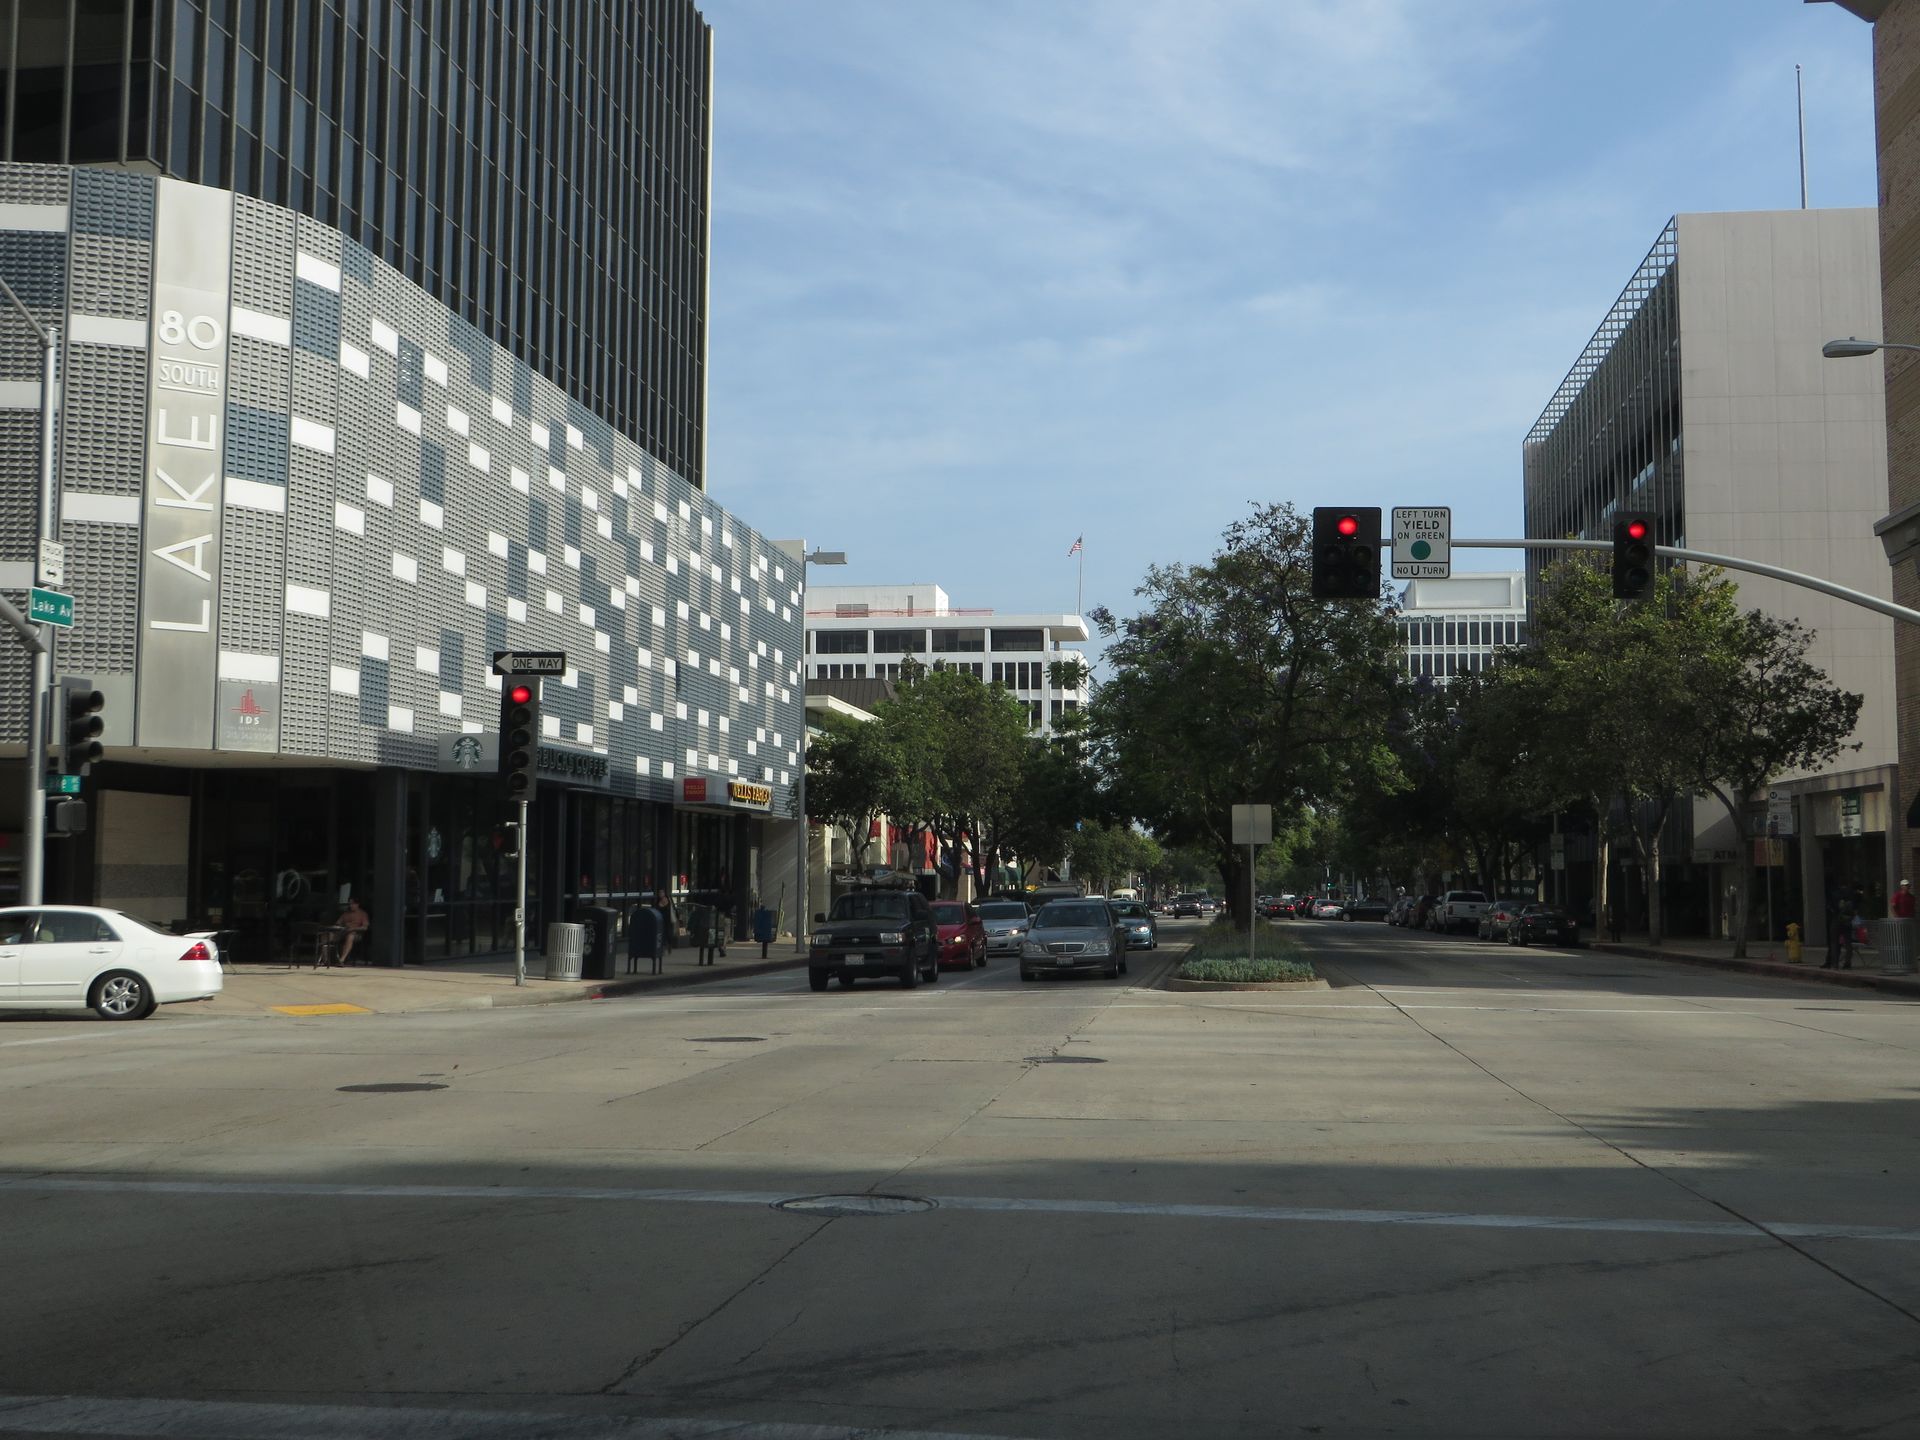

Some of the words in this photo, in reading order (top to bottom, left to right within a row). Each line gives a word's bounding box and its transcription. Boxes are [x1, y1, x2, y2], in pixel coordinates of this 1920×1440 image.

[159, 309, 223, 350] 80
[160, 363, 219, 389] SOUTH
[1396, 510, 1418, 519] LEFT
[1422, 510, 1446, 519] TURN
[150, 408, 217, 633] LAKE
[1403, 520, 1440, 530] YIELD
[1397, 531, 1410, 540] ON
[1415, 531, 1445, 540] GREEN
[1396, 566, 1409, 575] NO
[1410, 565, 1420, 576] U
[1422, 566, 1445, 575] TURN
[32, 597, 55, 615] Lake
[59, 604, 72, 618] Av
[512, 658, 533, 669] ONE
[538, 658, 560, 669] WAY
[239, 715, 261, 726] IDS
[732, 783, 752, 800] WELLS
[752, 785, 770, 804] FARGO
[1713, 849, 1737, 860] ATM
